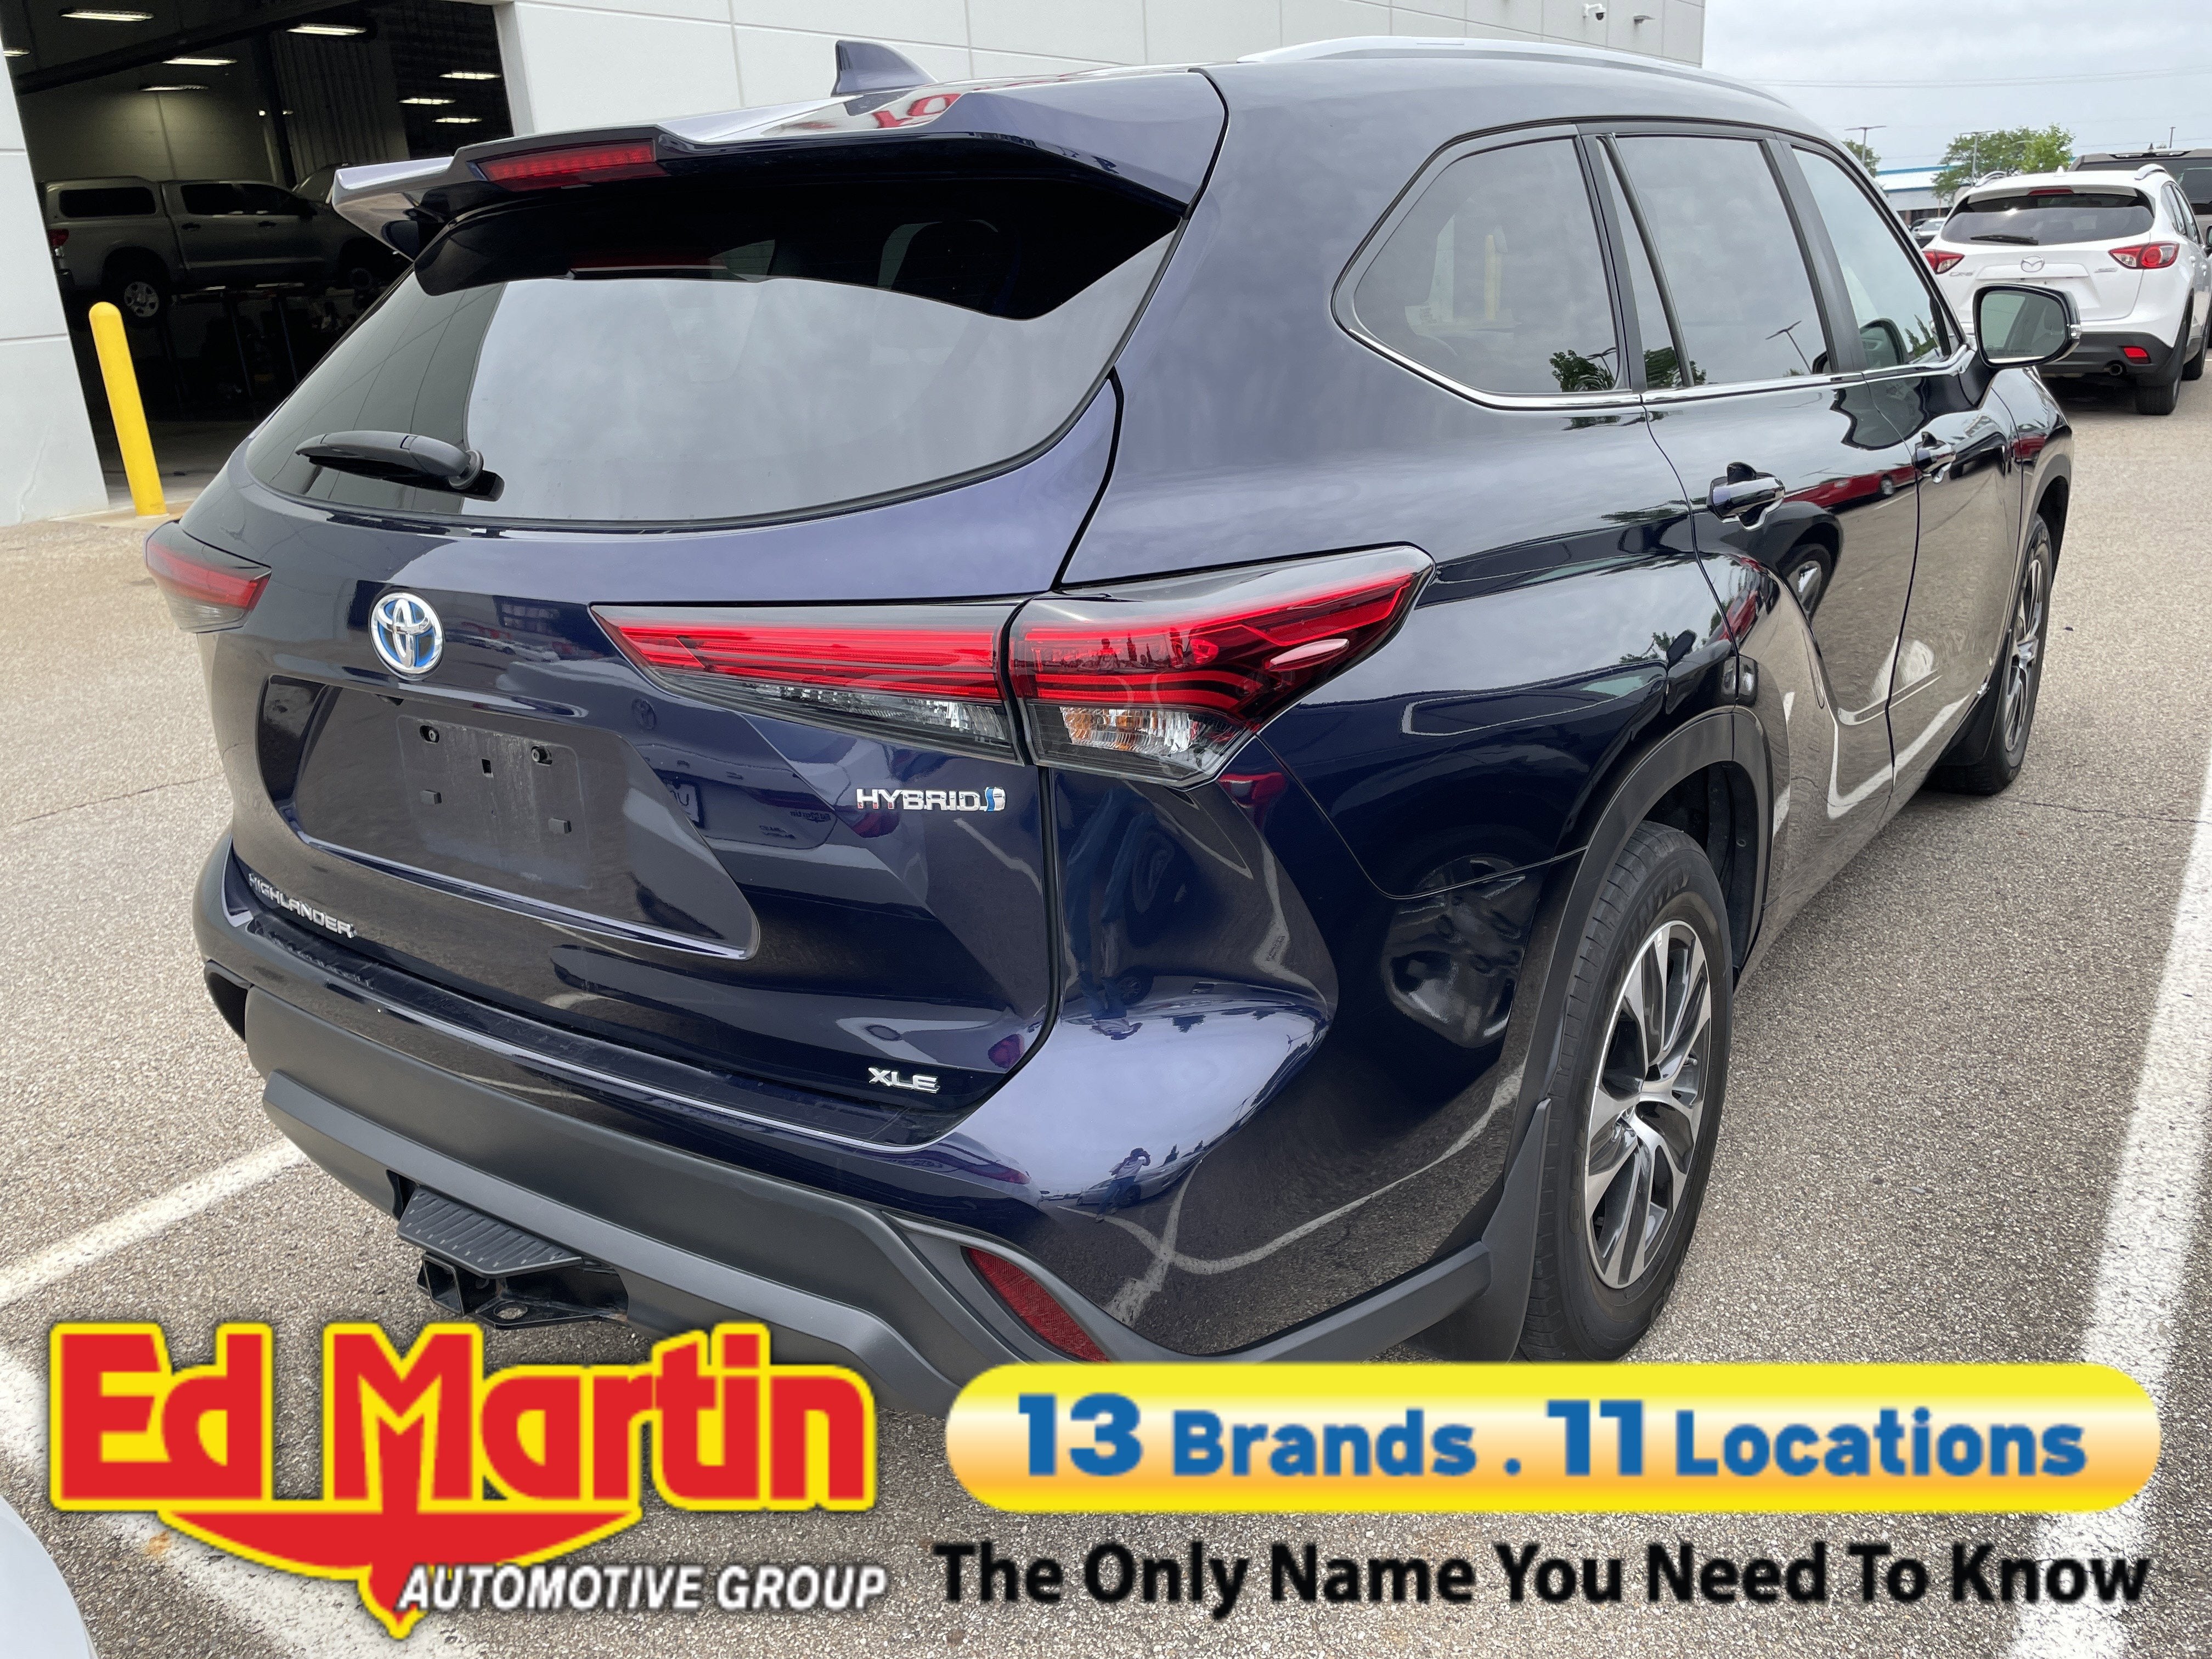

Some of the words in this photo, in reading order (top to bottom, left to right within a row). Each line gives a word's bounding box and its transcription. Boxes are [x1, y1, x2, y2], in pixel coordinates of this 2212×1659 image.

[856, 788, 981, 811] HYBRID
[249, 872, 357, 939] HIGHLANDER
[868, 1066, 940, 1094] XLE
